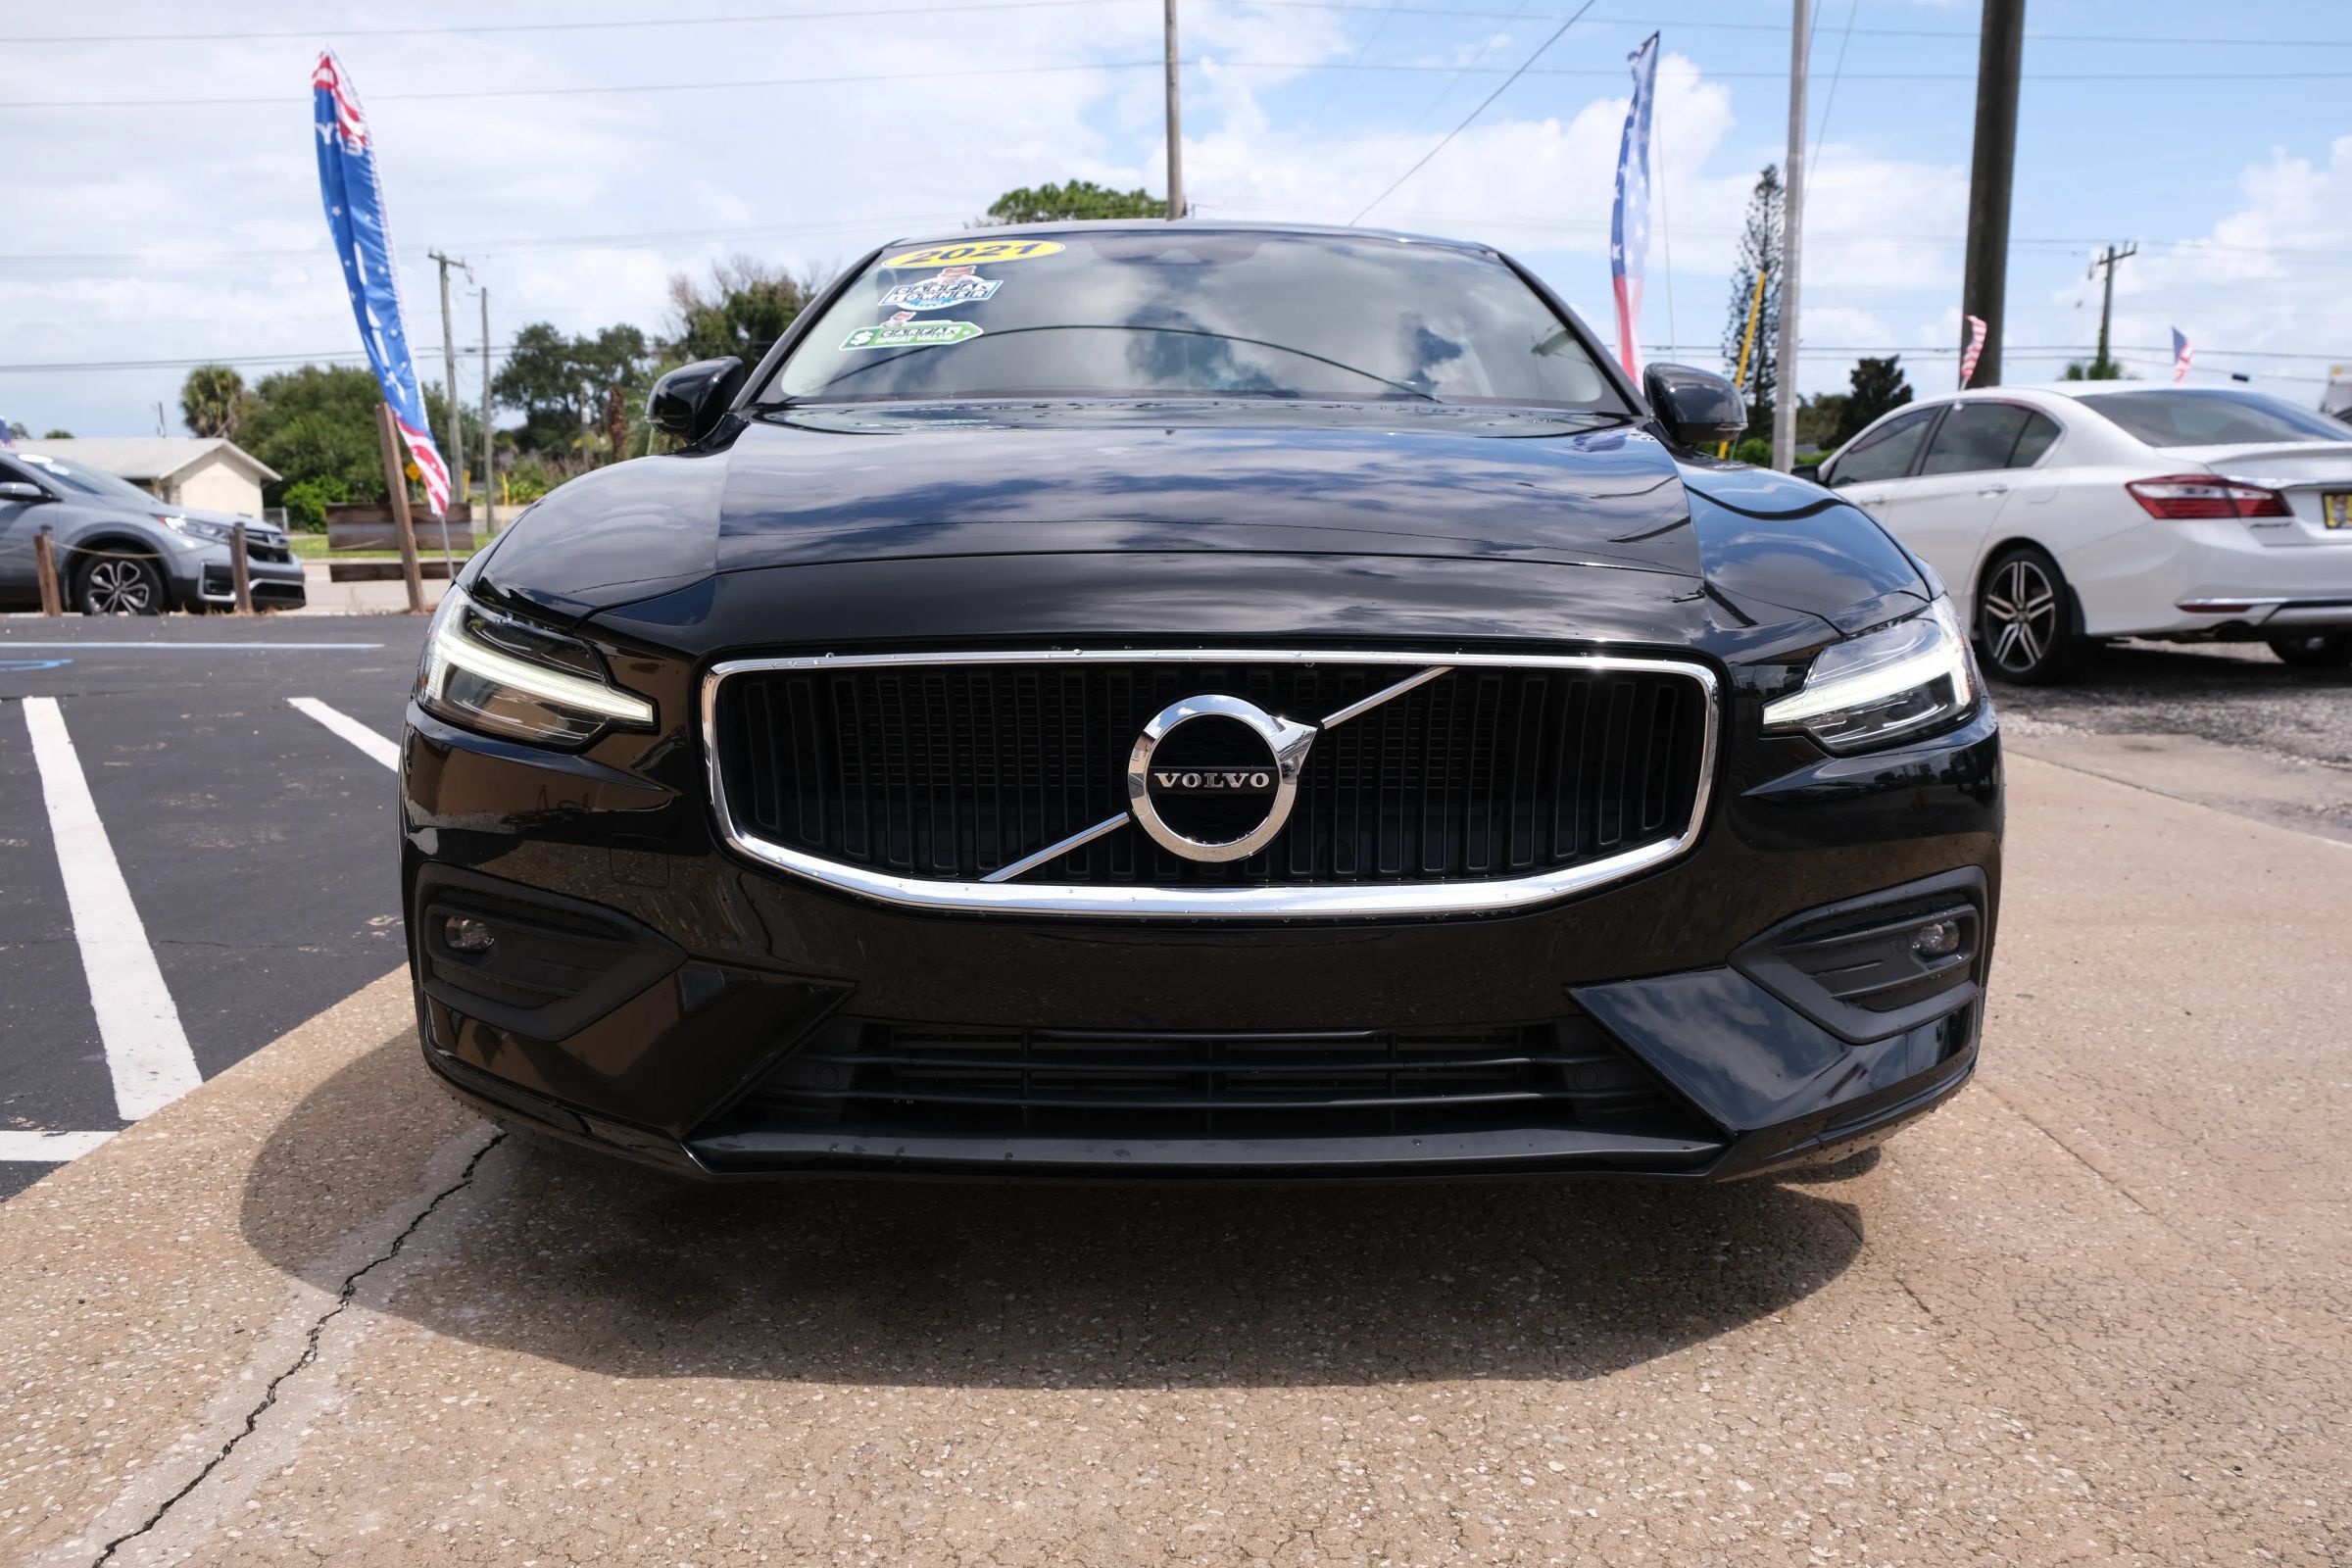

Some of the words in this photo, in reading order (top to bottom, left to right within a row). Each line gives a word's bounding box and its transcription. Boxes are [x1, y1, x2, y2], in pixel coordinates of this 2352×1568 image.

[900, 243, 1042, 265] 2021
[896, 280, 993, 294] CARFAX
[906, 290, 985, 301] OWNER
[882, 326, 960, 336] CARFAX
[1154, 772, 1270, 788] VOLVO
